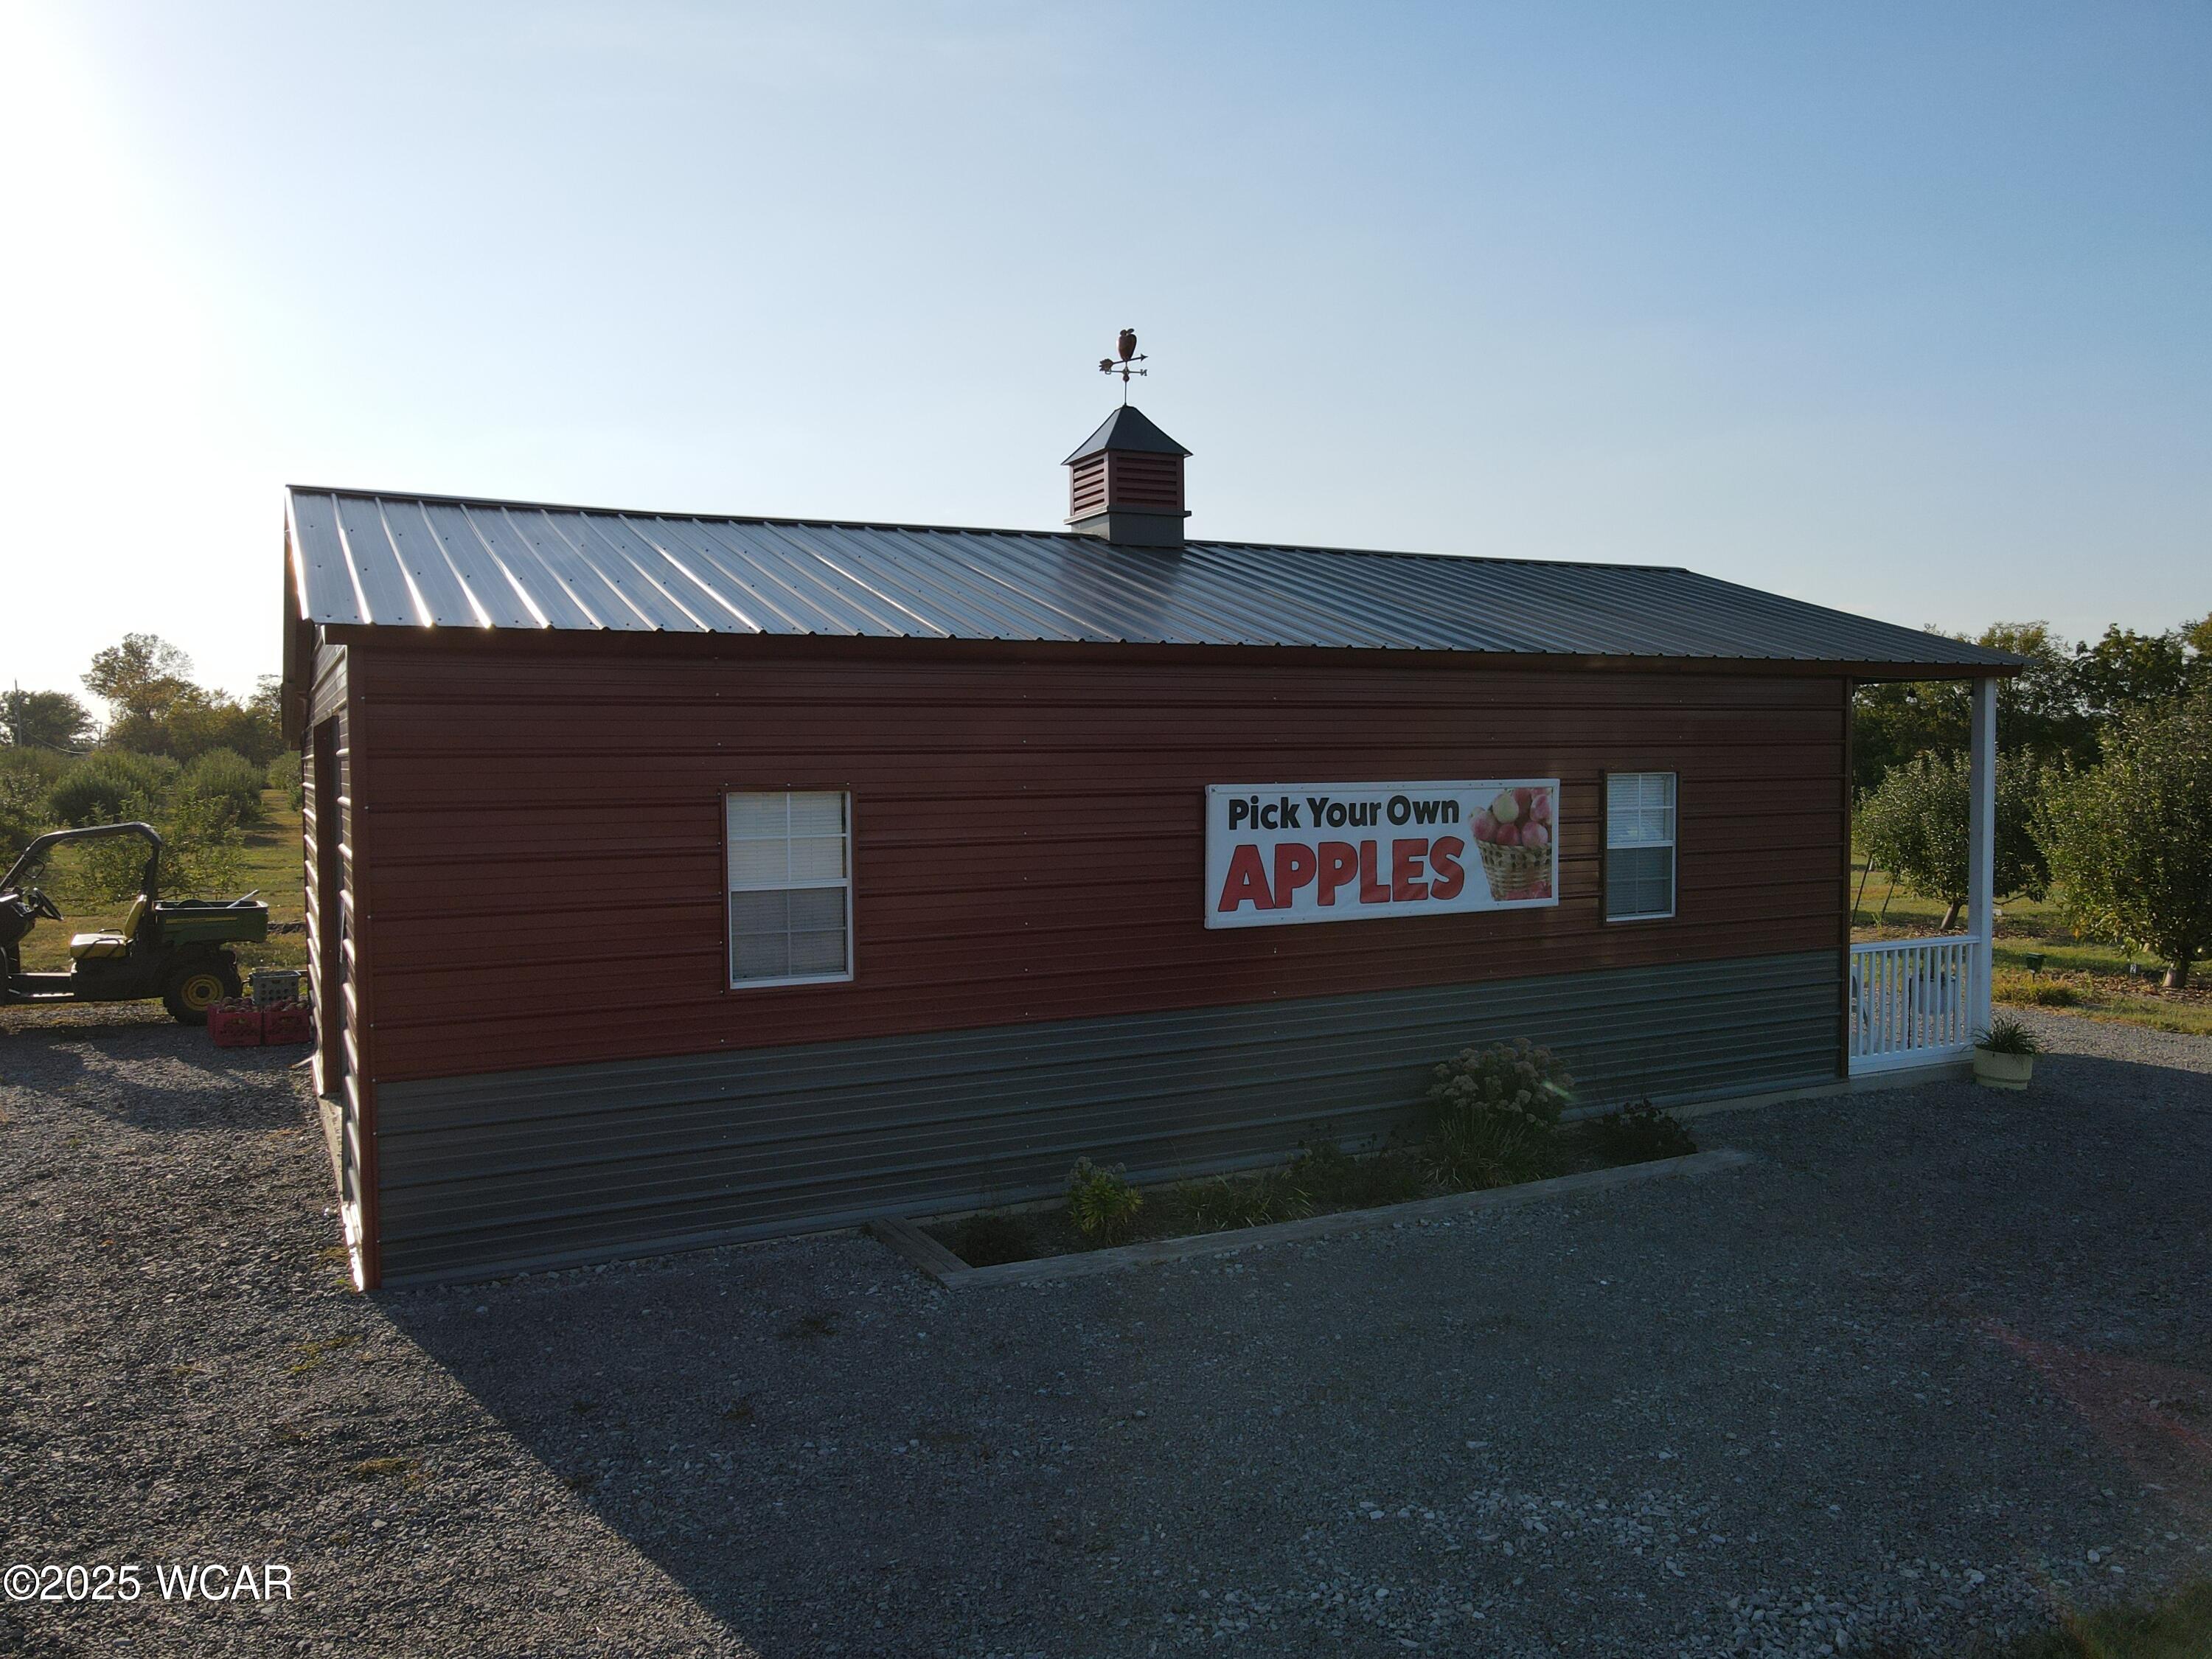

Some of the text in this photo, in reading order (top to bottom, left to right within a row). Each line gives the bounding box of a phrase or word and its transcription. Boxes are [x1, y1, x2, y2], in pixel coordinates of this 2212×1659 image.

[1228, 795, 1459, 830] Pick Your Own
[1217, 836, 1465, 912] APPLES
